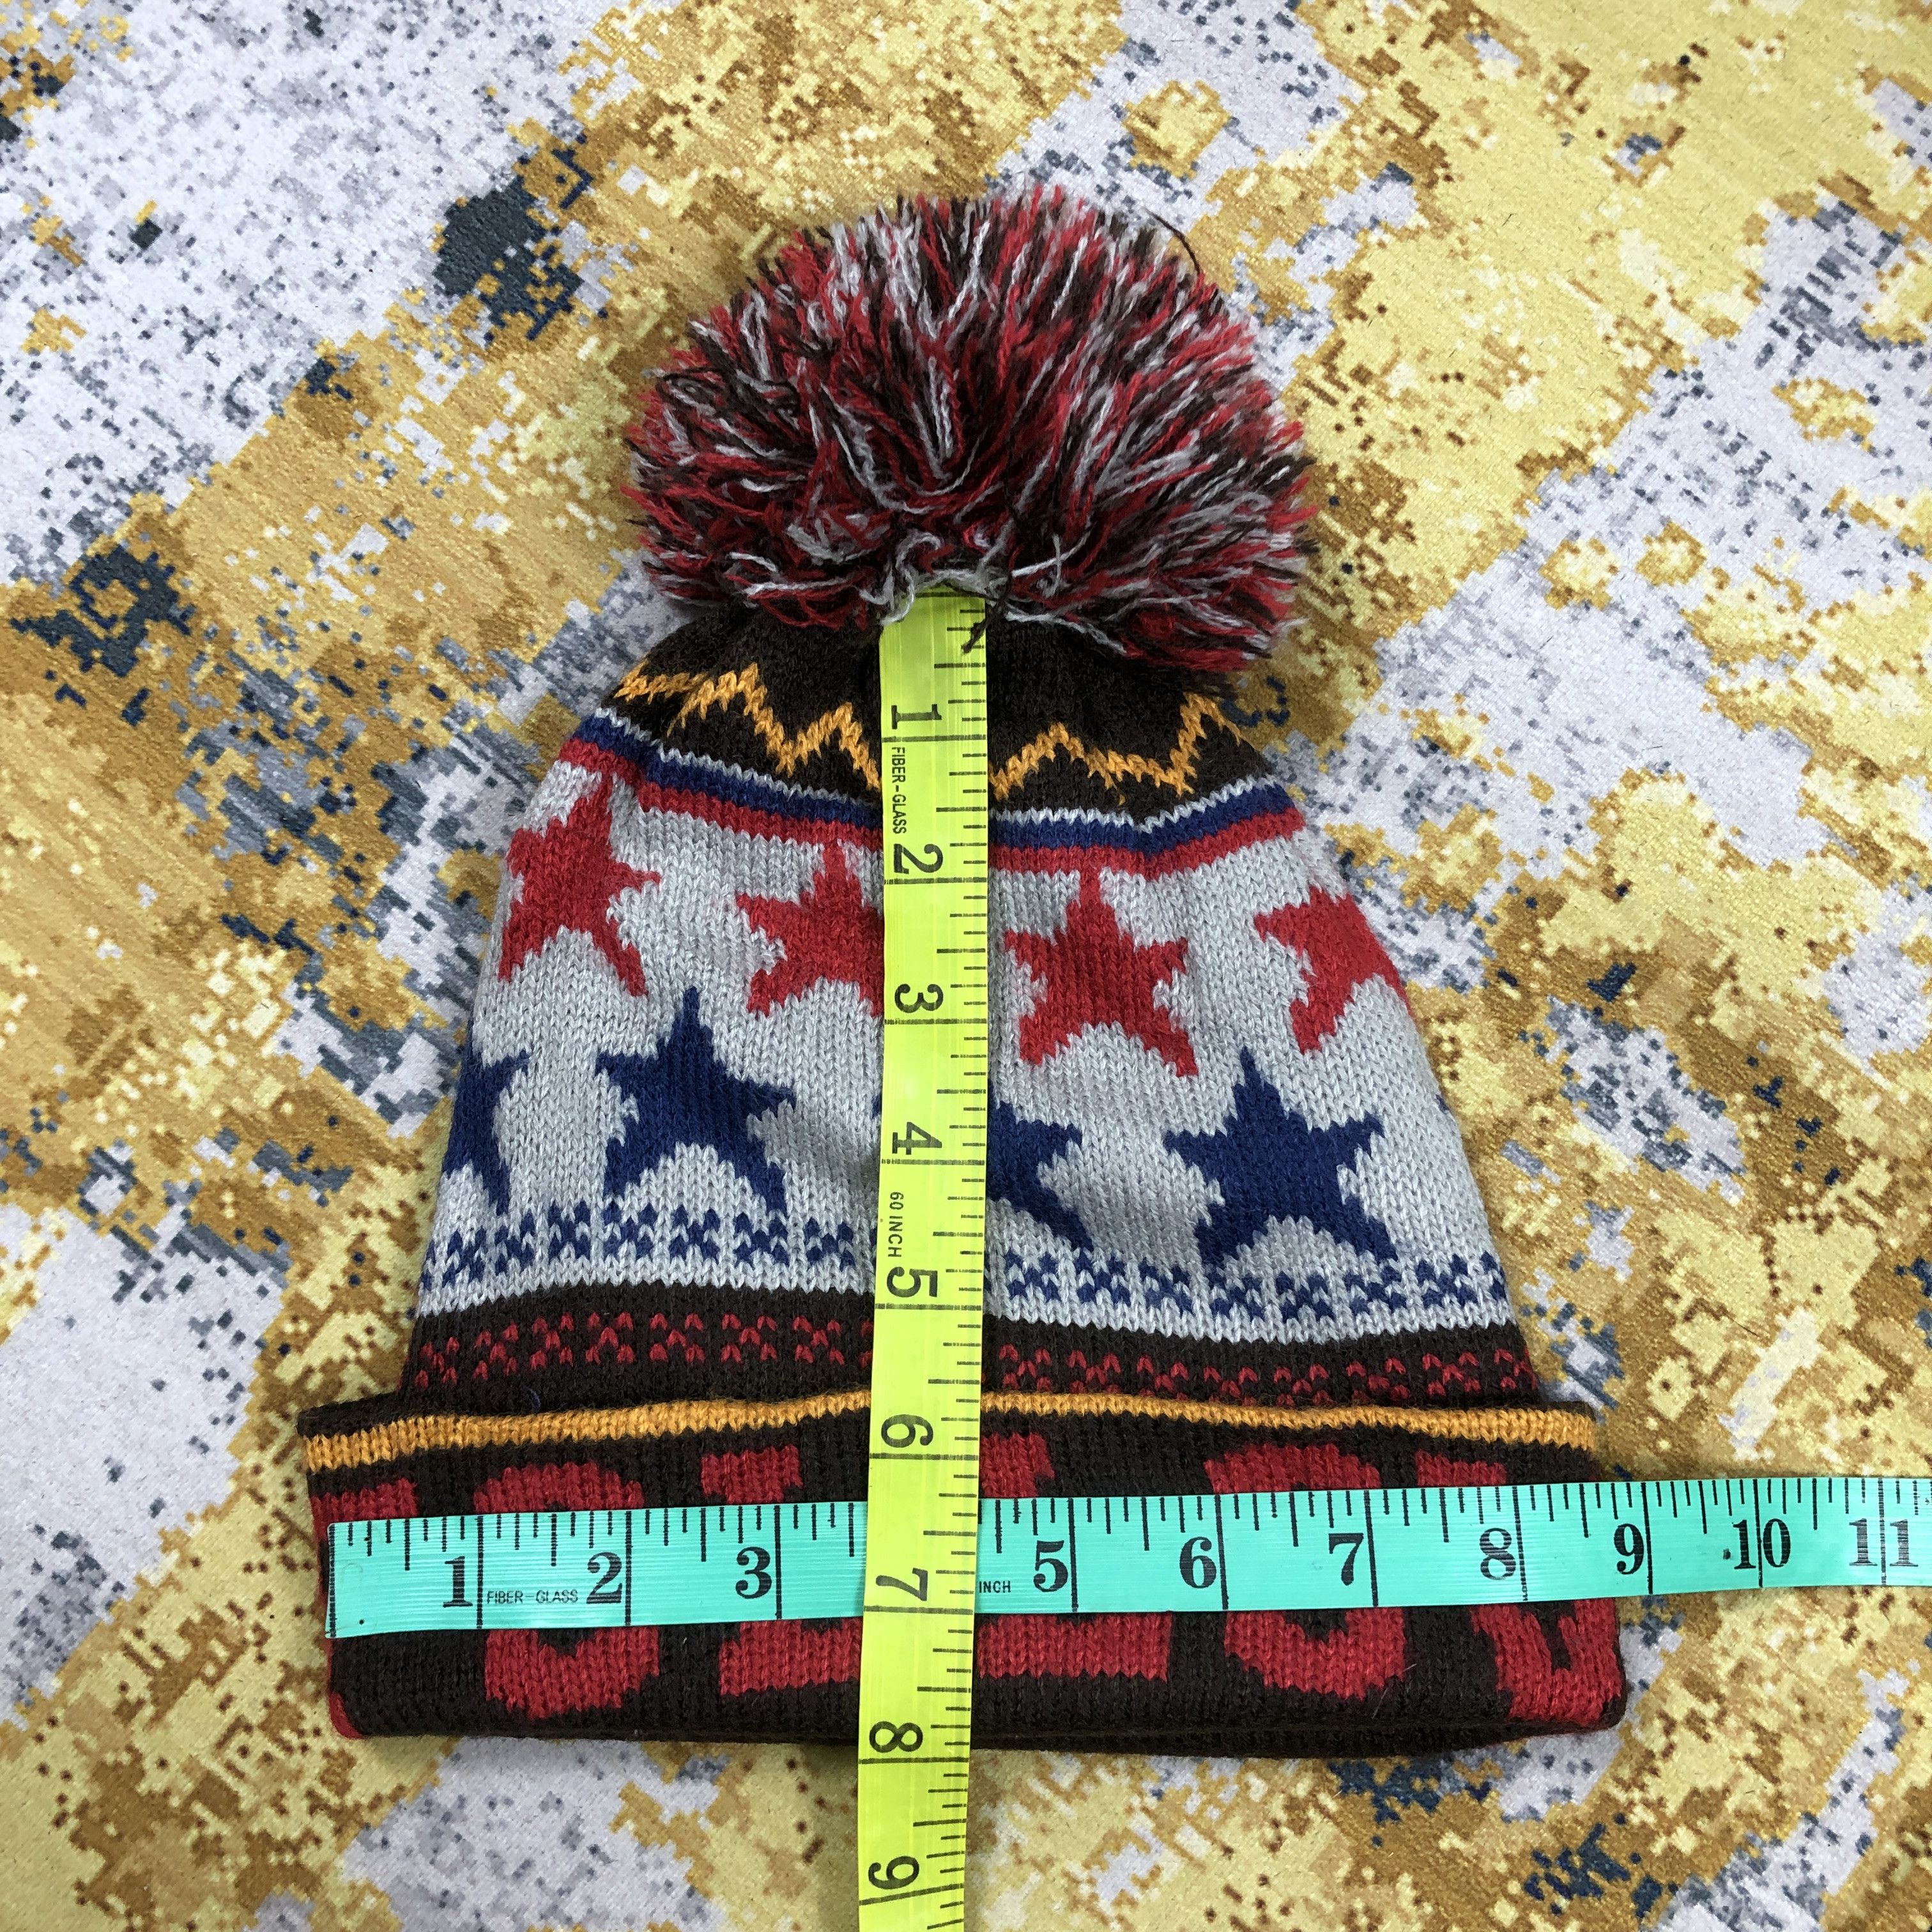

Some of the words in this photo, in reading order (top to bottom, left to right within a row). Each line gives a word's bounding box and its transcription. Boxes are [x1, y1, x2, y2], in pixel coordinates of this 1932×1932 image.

[891, 703, 942, 730] 1
[892, 747, 907, 834] FIBER-GLASS
[893, 843, 944, 874] 2
[894, 983, 944, 1013] 3
[892, 1121, 943, 1155] 4
[889, 1192, 905, 1210] 60
[887, 1216, 903, 1258] INCH
[886, 1266, 939, 1298] 5
[880, 1414, 934, 1447] 6
[1328, 1533, 1363, 1586] 7
[1480, 1528, 1516, 1581] 8
[1613, 1523, 1644, 1575] 9
[1733, 1518, 1791, 1570] 10
[1849, 1518, 1919, 1567] 11
[442, 1556, 473, 1607] 1
[586, 1552, 622, 1604] 2
[735, 1546, 771, 1598] 3
[1032, 1540, 1068, 1592] 5
[1179, 1537, 1216, 1589] 6
[486, 1588, 578, 1604] FIBER-GLASS
[875, 1567, 928, 1601] 7
[979, 1580, 1011, 1593] INCH
[869, 1721, 923, 1752] 8
[868, 1855, 919, 1890] 9
